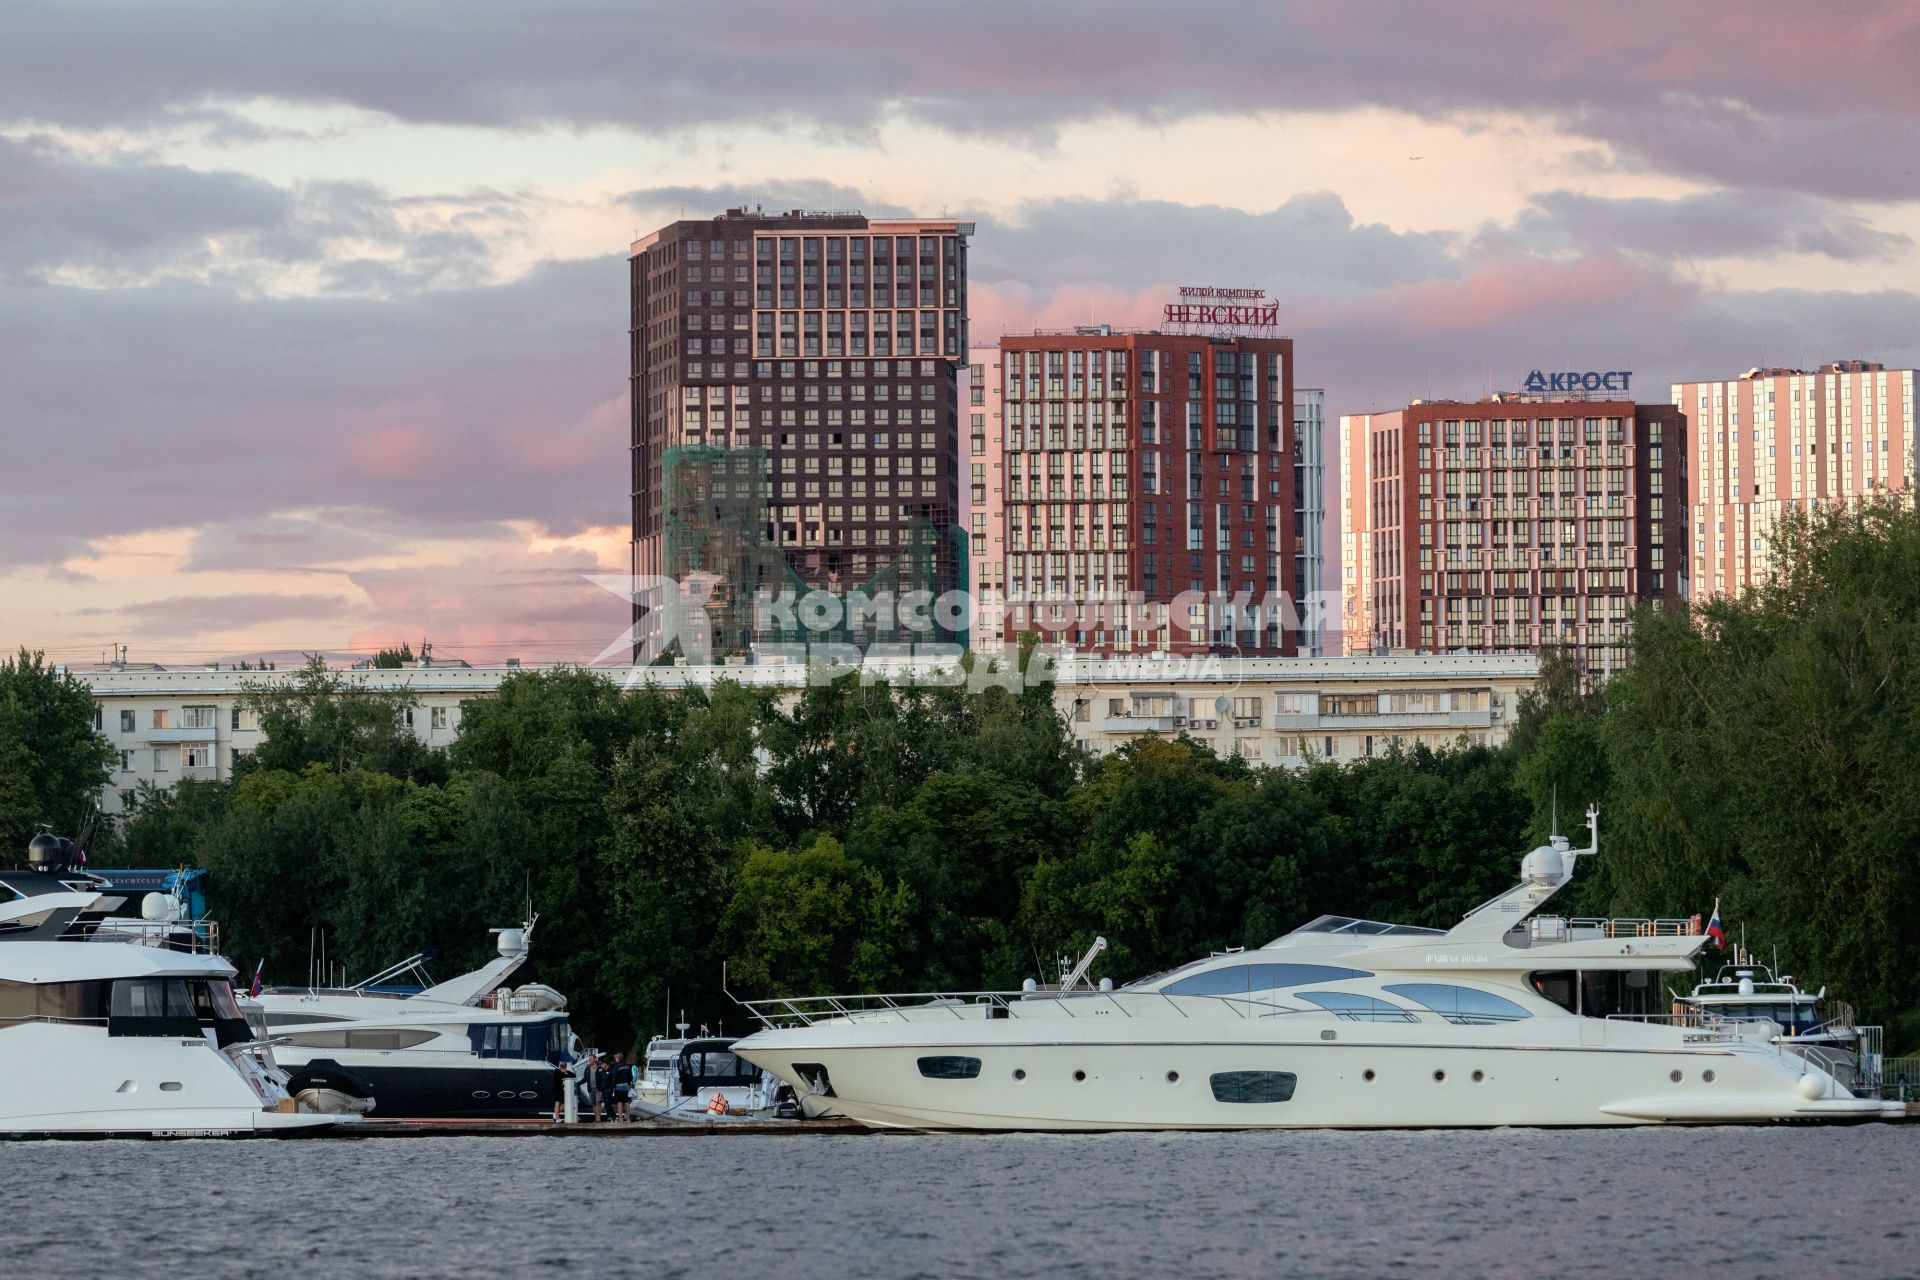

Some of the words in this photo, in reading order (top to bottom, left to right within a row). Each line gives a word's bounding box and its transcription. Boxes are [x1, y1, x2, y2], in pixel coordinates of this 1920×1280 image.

[1179, 286, 1214, 297] ЖИЛОЙ
[1216, 288, 1266, 299] КОМПЛЕКС
[1164, 298, 1280, 330] НЕВСКИЙ
[151, 1129, 230, 1137] SUNSEEKER
